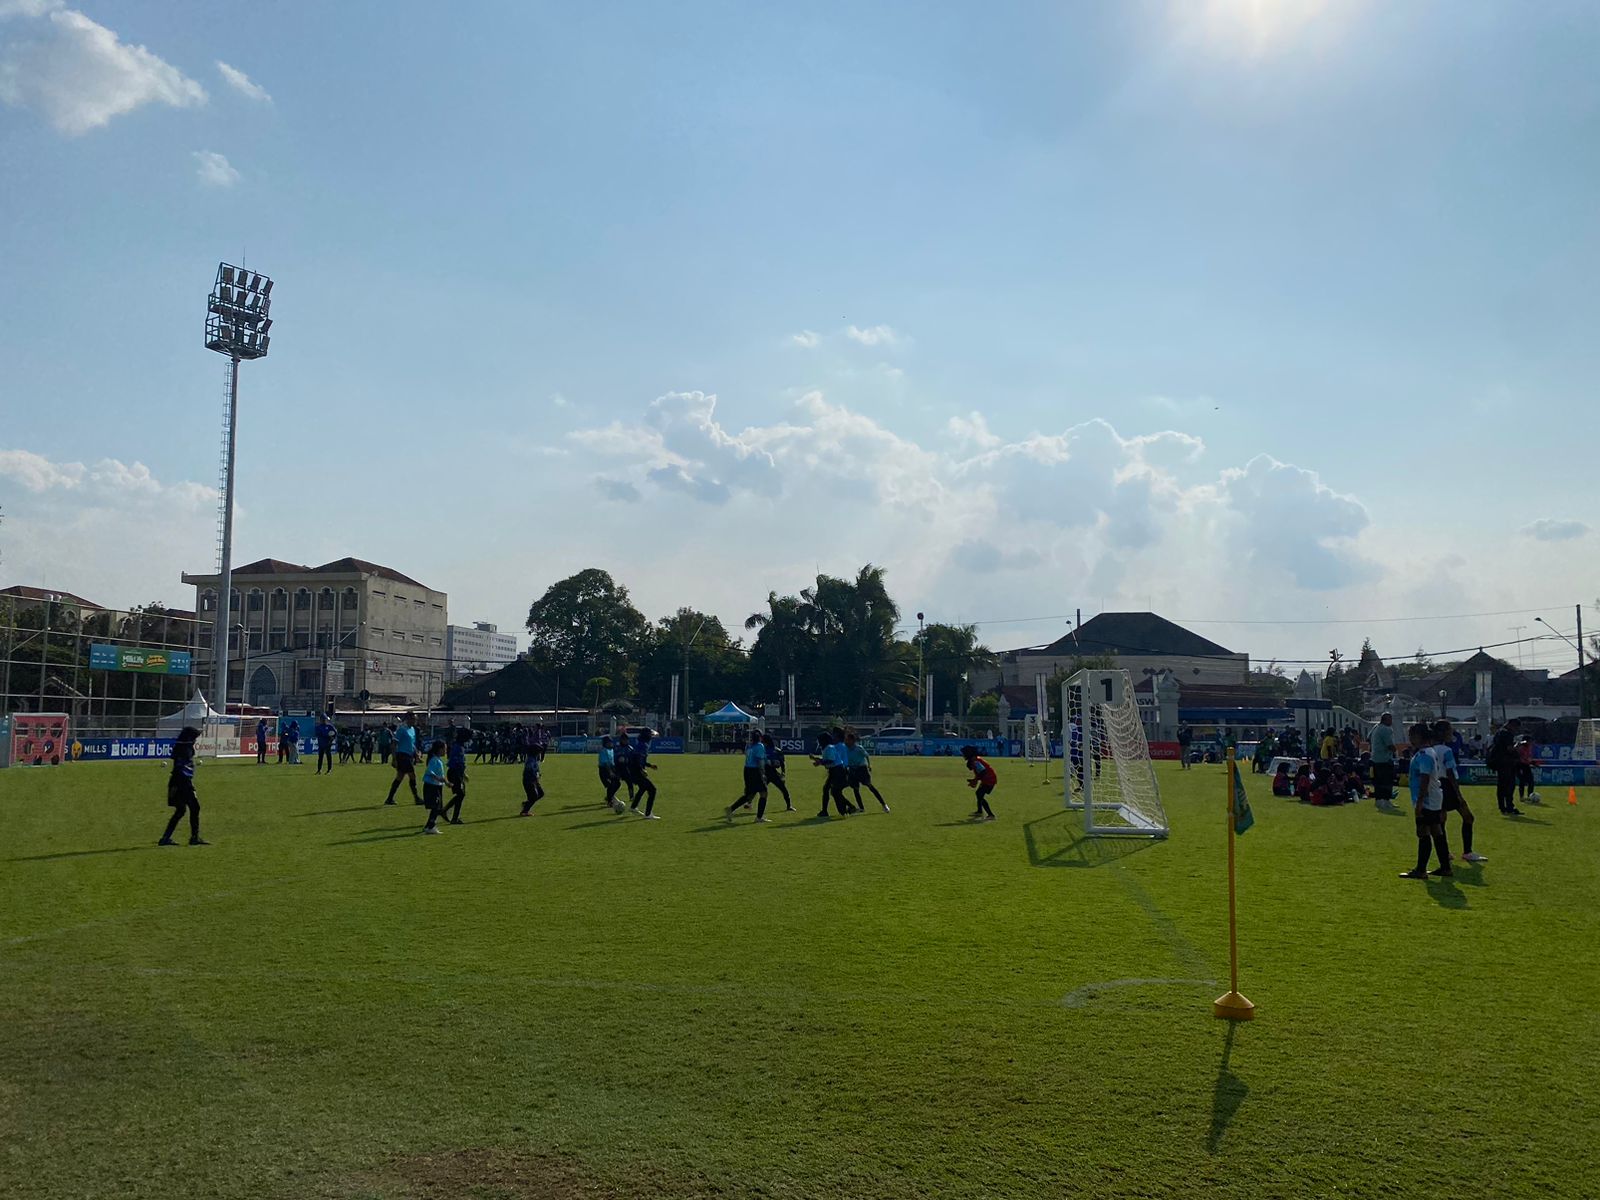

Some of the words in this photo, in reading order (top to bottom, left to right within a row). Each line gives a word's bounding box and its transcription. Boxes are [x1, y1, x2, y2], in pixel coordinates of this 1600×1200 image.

[1100, 678, 1112, 702] 1
[1030, 716, 1036, 724] 3
[84, 745, 107, 753] MILLS
[120, 743, 144, 756] blibli
[156, 743, 173, 756] blib
[248, 742, 280, 752] POTRO
[780, 740, 804, 751] PSSI
